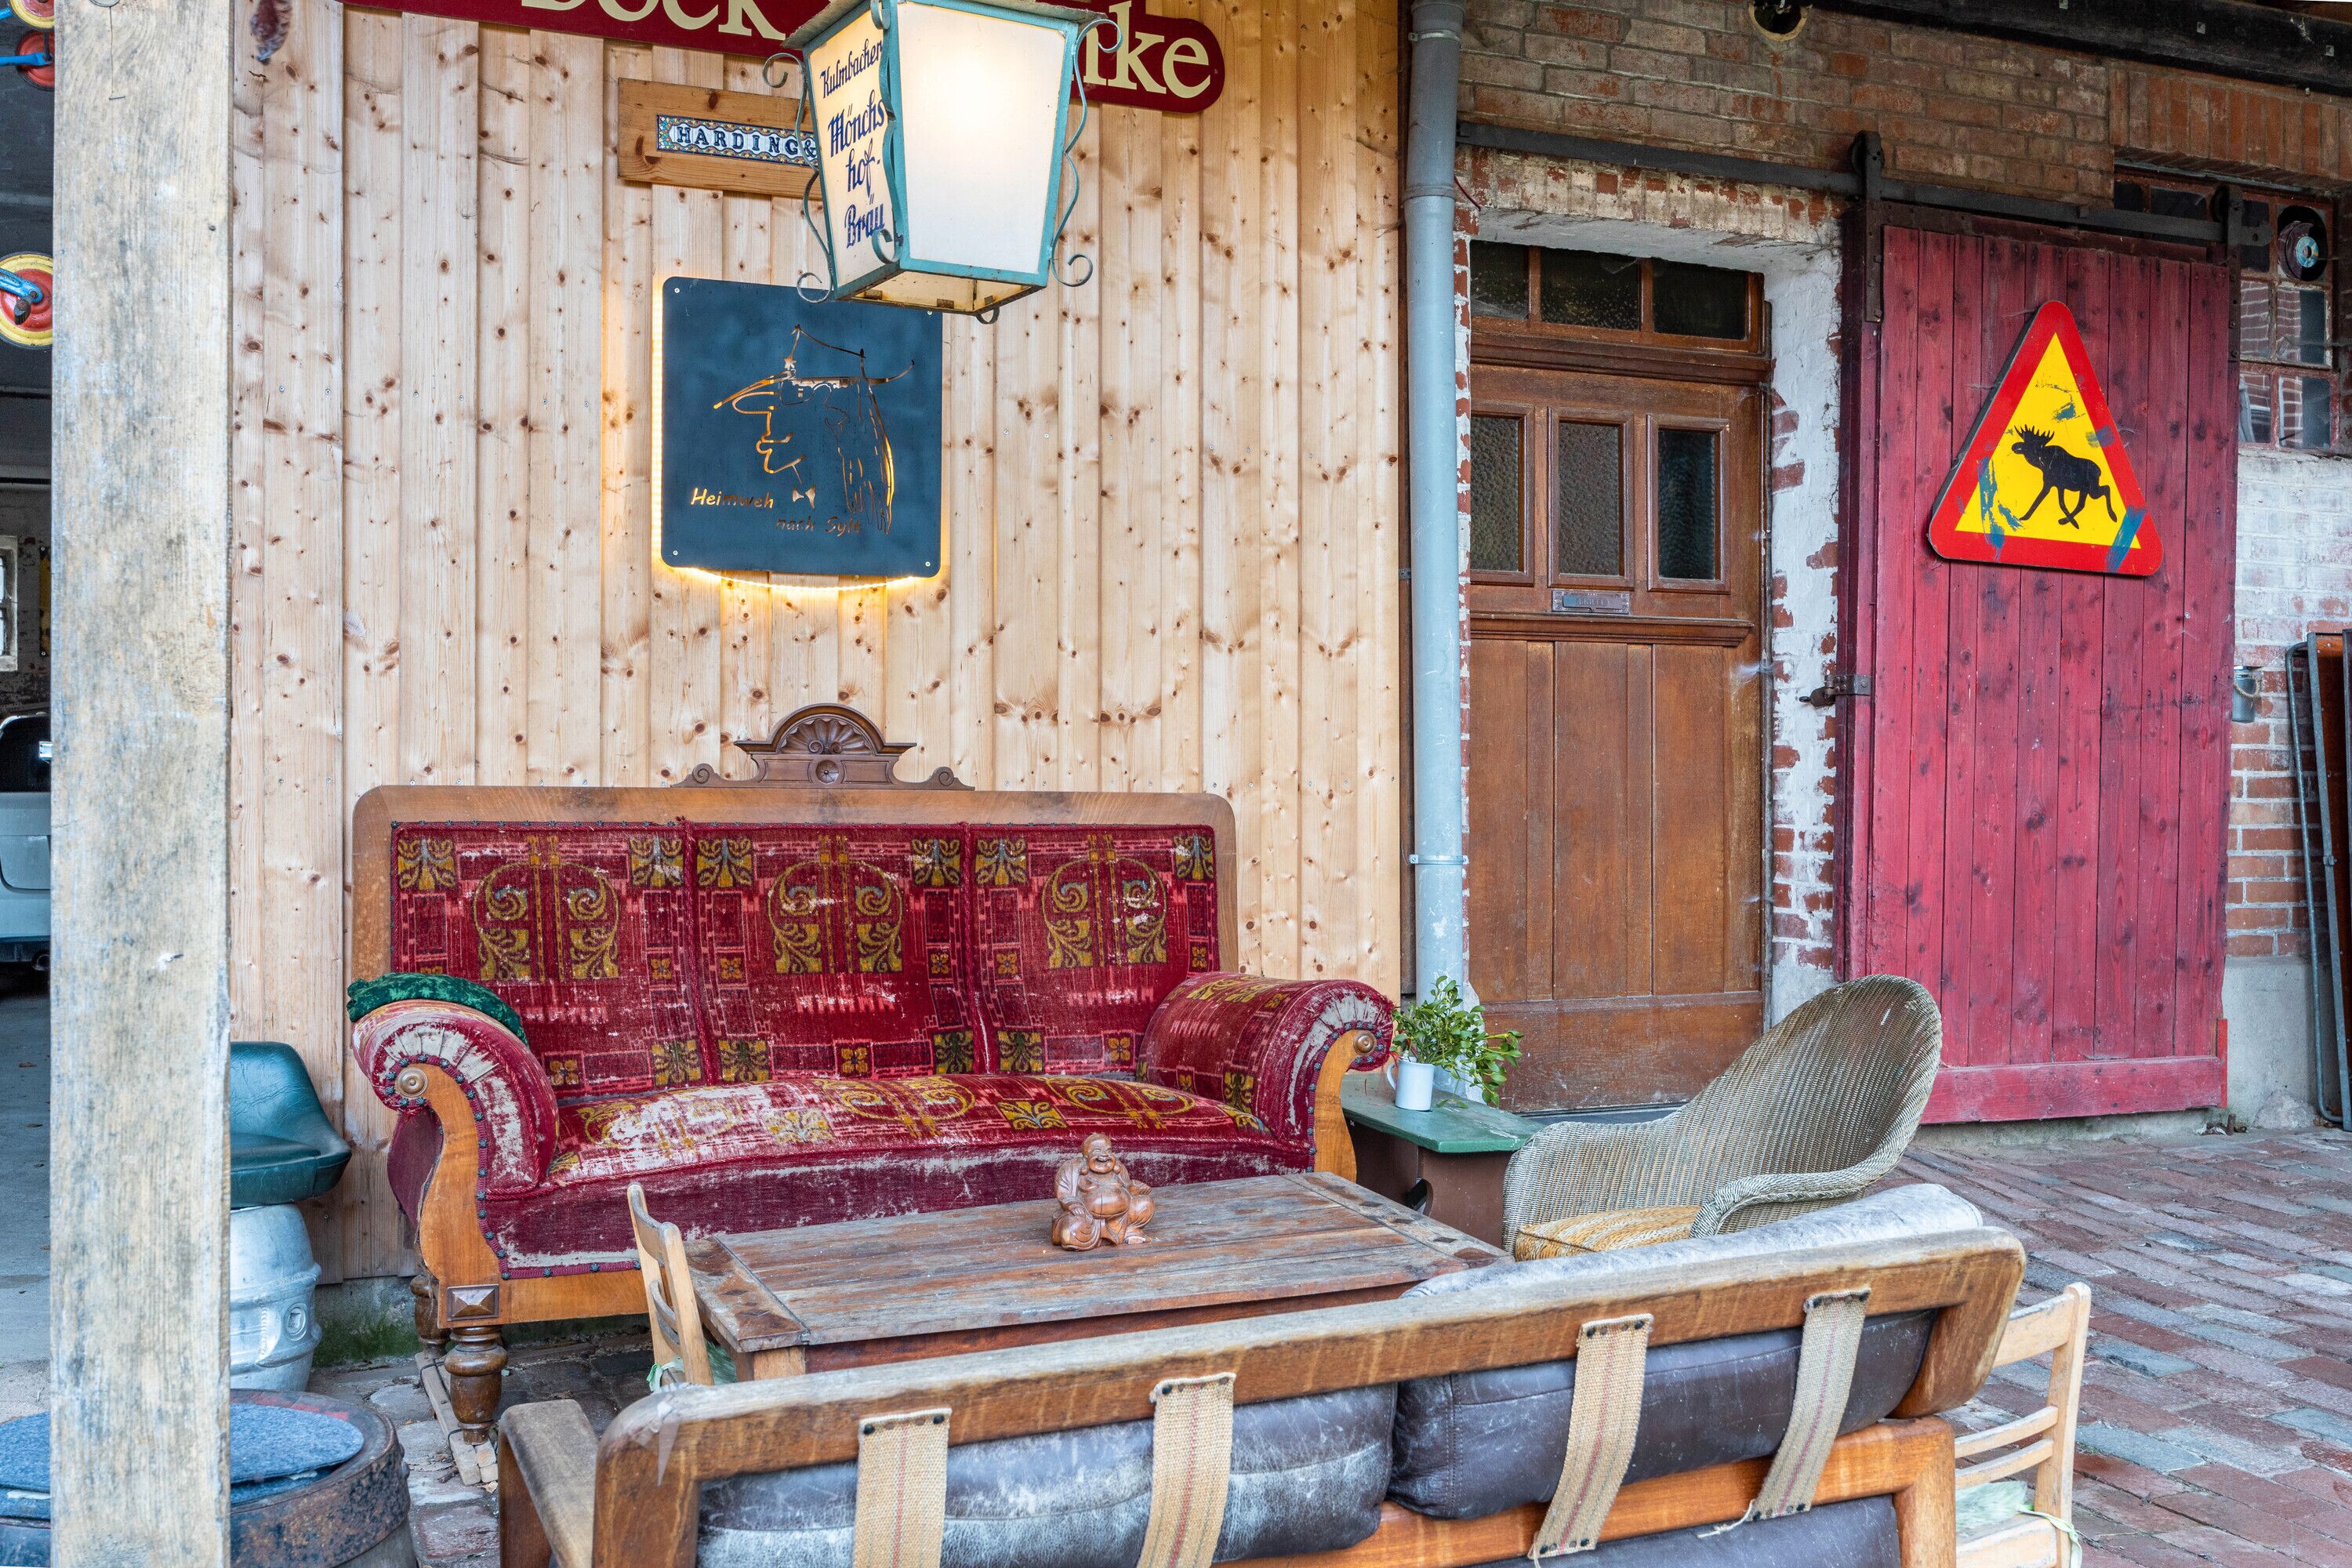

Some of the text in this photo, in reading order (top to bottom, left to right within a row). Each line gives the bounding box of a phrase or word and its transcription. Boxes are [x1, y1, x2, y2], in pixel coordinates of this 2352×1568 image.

[819, 38, 883, 99] Kulmbacher
[828, 89, 884, 158] Mönchs
[691, 488, 774, 508] Heimweh
[776, 516, 862, 537] nach Sylt
